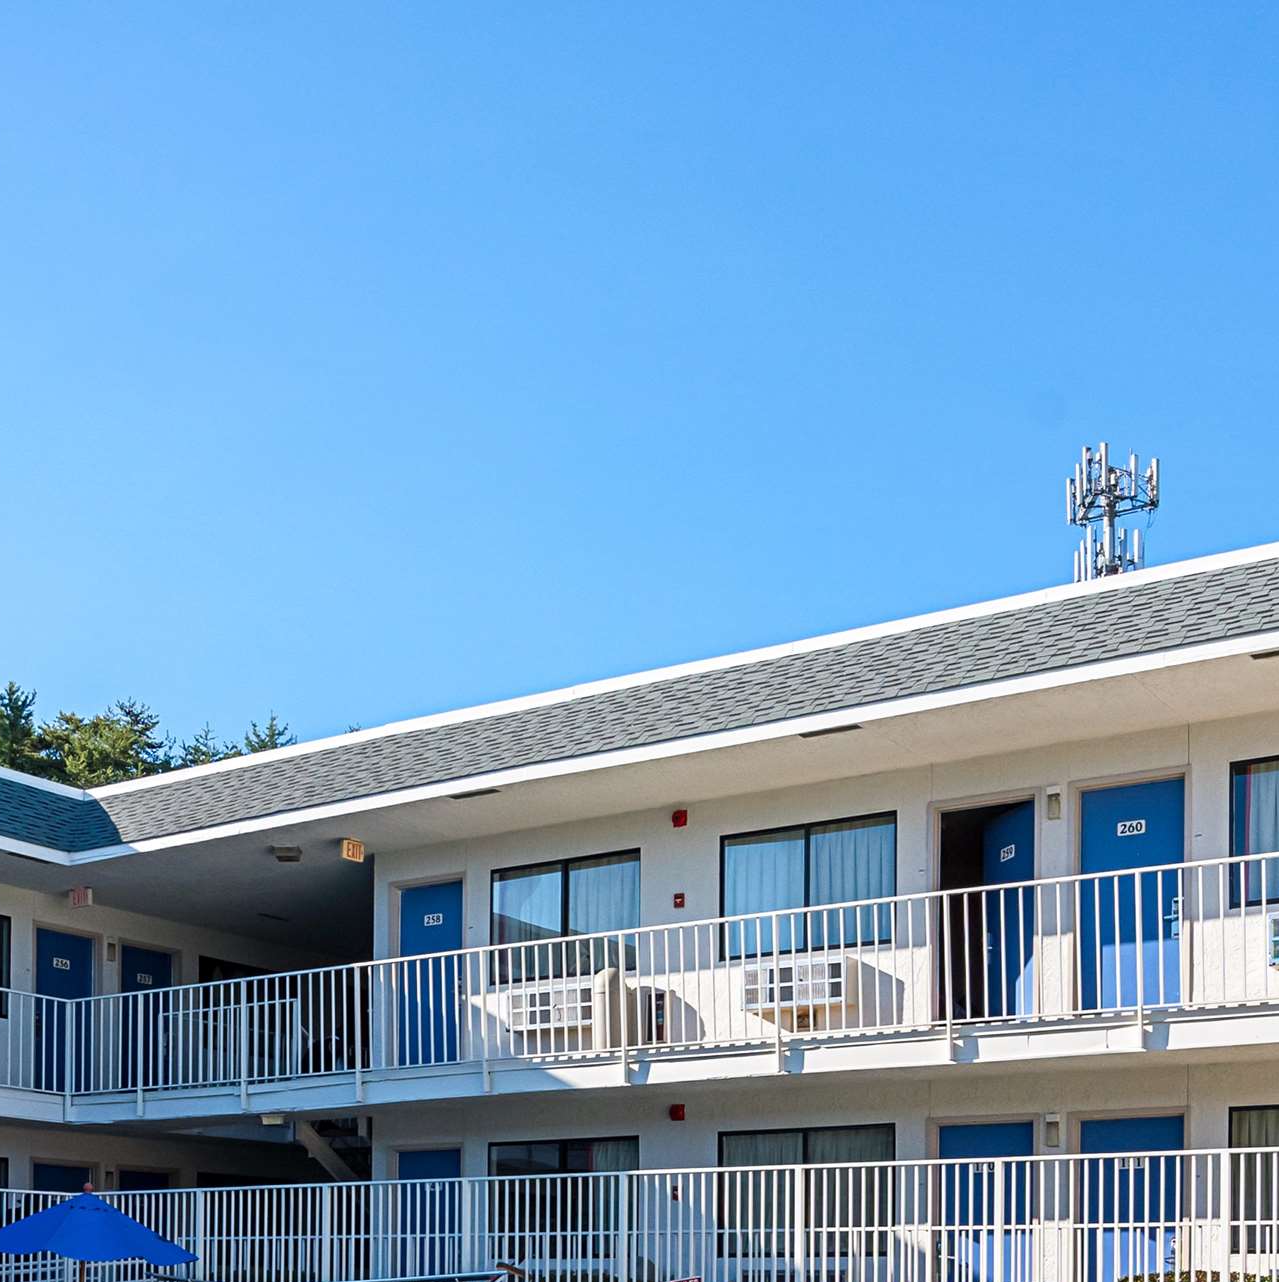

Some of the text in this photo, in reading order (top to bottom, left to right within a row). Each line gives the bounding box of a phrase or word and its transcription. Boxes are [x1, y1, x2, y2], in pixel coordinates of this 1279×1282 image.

[1119, 821, 1143, 834] 260
[346, 841, 361, 860] EXIT
[425, 914, 441, 925] 258
[55, 958, 69, 969] 256
